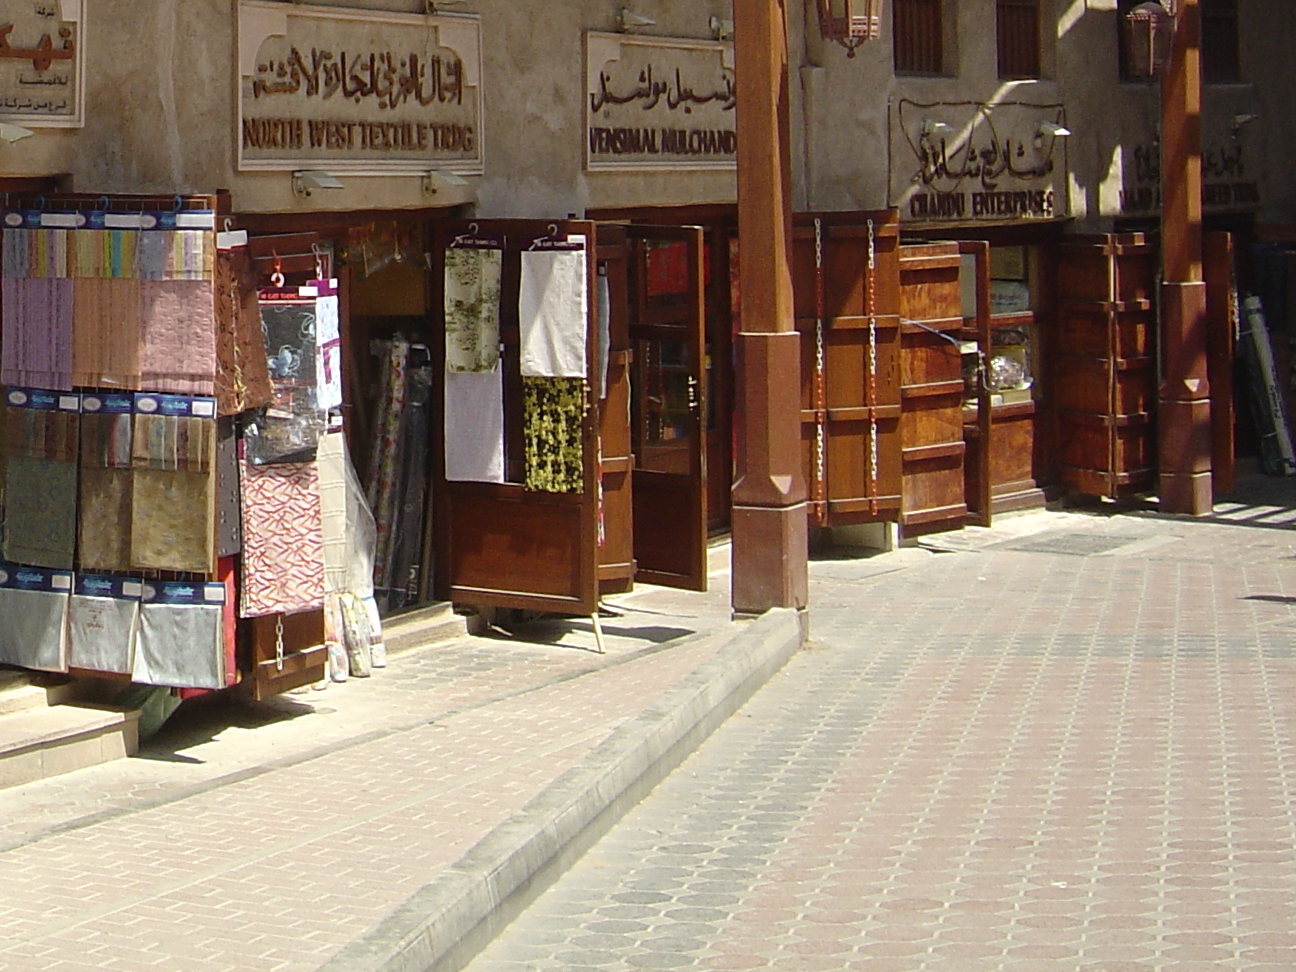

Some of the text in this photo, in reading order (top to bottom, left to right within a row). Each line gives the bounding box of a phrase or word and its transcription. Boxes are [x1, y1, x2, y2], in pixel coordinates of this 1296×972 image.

[243, 118, 474, 152] NORTH WEST TEXTILE TRDG
[972, 190, 1054, 217] ENTERPRISES
